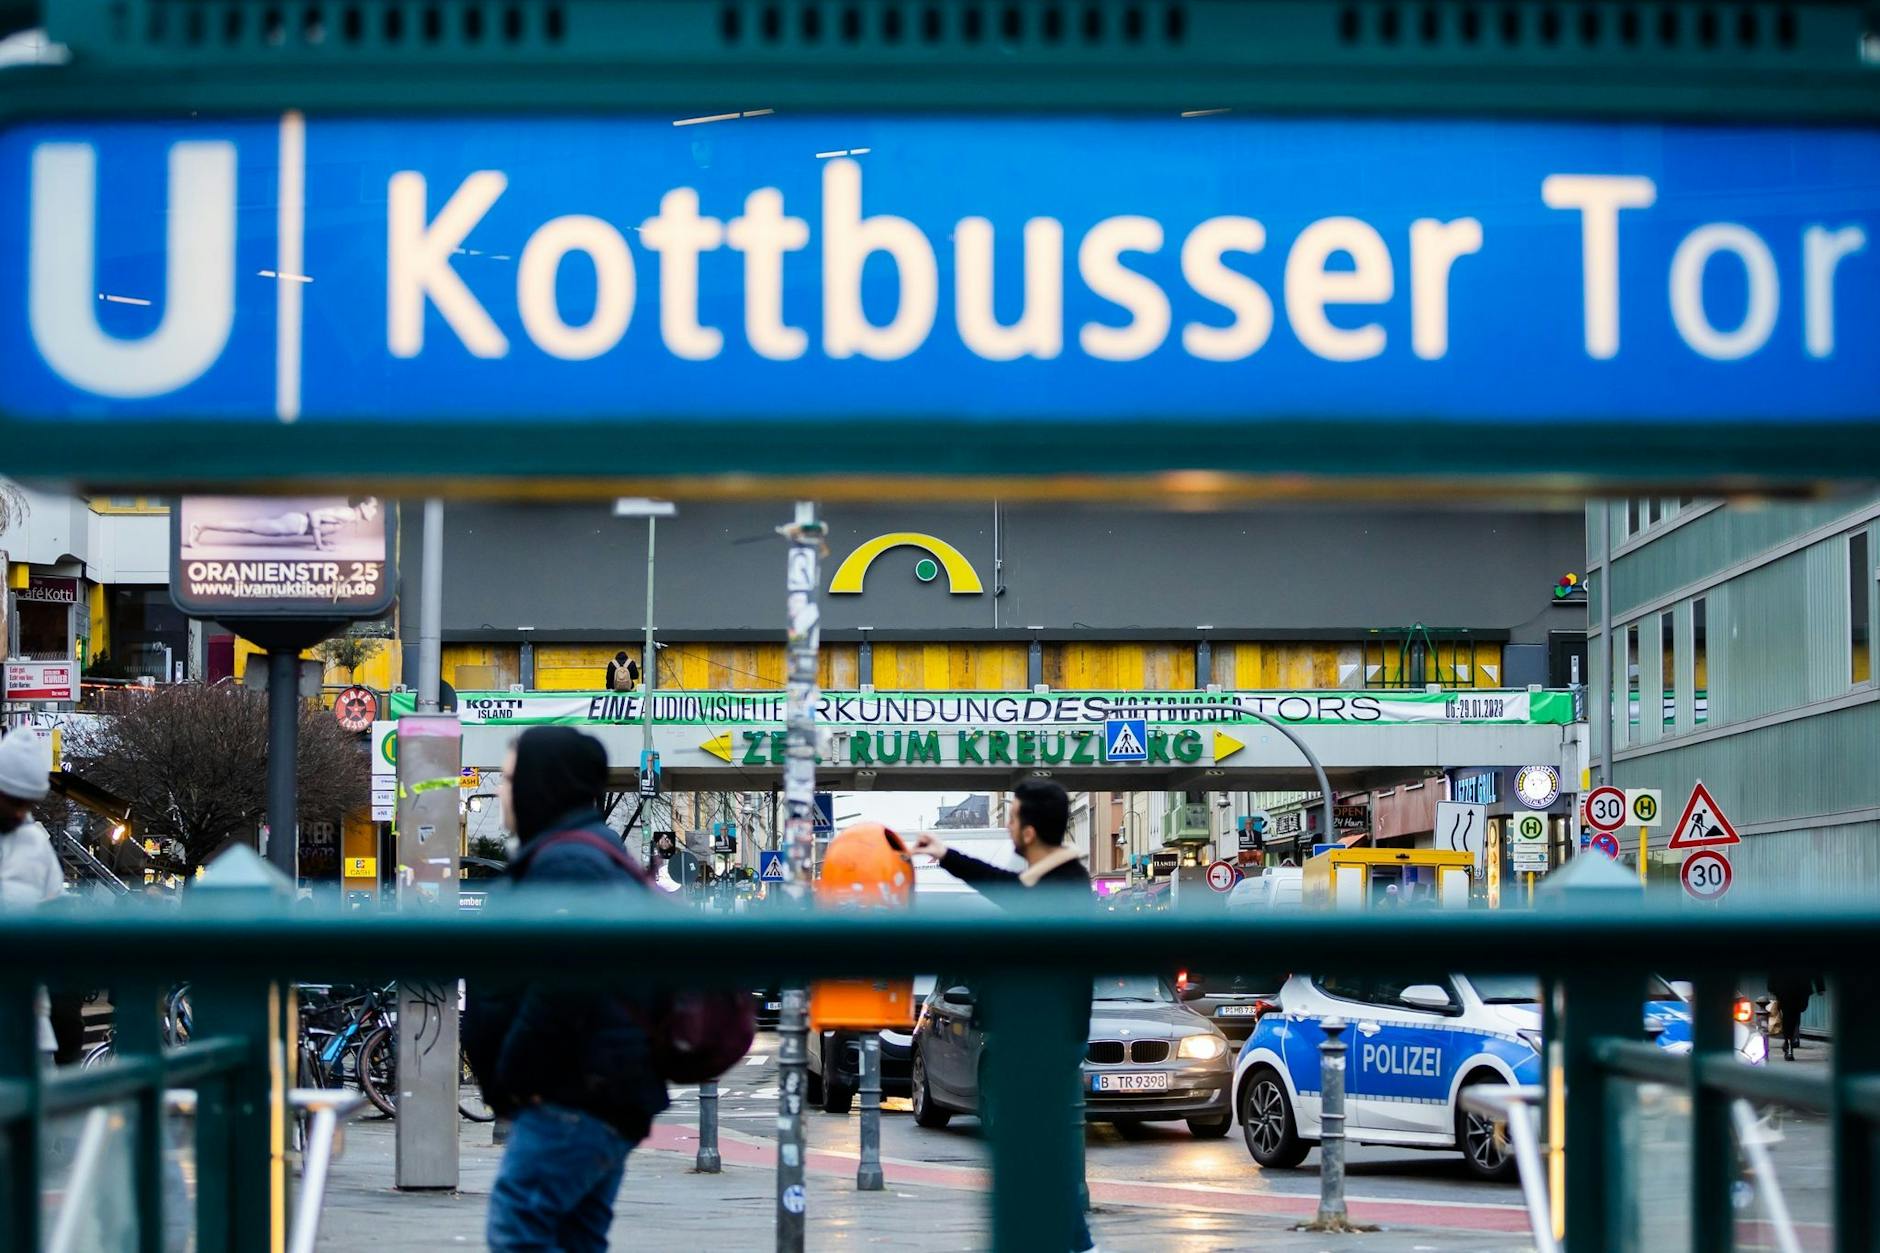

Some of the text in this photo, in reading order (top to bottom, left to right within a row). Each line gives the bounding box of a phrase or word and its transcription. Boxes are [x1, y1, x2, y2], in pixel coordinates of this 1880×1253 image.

[30, 140, 1866, 397] U Kottbusser Tor
[188, 562, 379, 582] ORANIENSTR. 25
[45, 587, 74, 601] Kotti
[190, 581, 376, 598] www.jivamuktiberlin.de
[466, 699, 523, 709] KOTTI
[587, 696, 638, 721] EINE
[816, 697, 1020, 722] RKUNDUNG
[1023, 697, 1110, 722] DES
[1246, 696, 1382, 721] TORS
[477, 709, 513, 719] ISLAND
[742, 729, 1204, 765] ZETRUM KREUZRG
[1333, 806, 1364, 817] OPEN
[1594, 799, 1620, 819] 30
[1640, 800, 1652, 815] H
[1526, 822, 1537, 834] H
[1693, 863, 1722, 887] 30
[459, 896, 483, 906] ember
[1363, 1043, 1442, 1077] POLIZEI
[1101, 1075, 1165, 1089] B TR 9398
